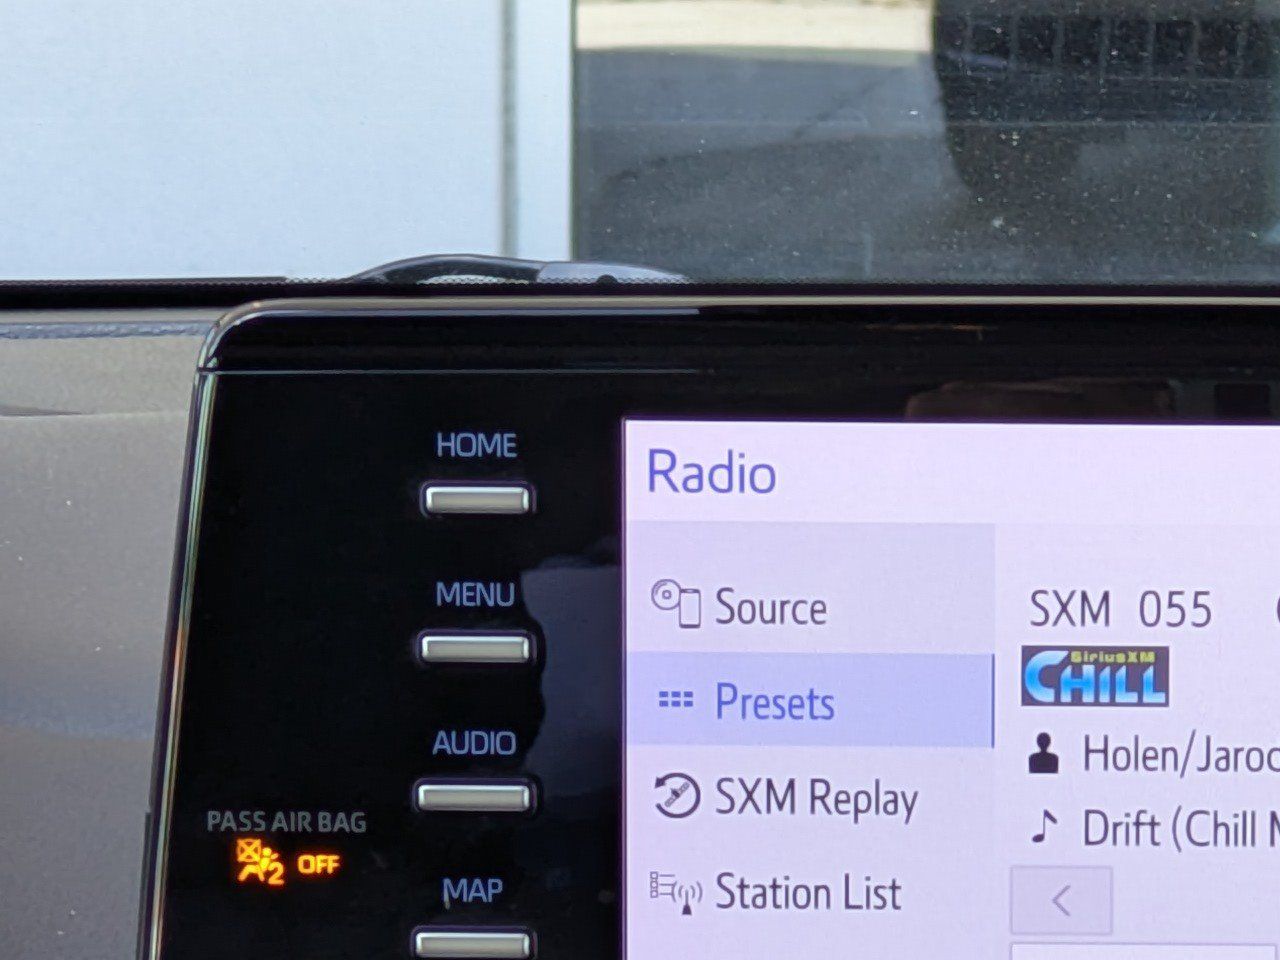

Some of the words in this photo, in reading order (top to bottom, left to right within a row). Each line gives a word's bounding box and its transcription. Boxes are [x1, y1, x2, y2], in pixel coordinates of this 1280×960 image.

[438, 432, 517, 458] HOME
[648, 448, 777, 494] Radio
[436, 581, 515, 607] MENU
[715, 586, 828, 626] Source
[1030, 589, 1111, 627] SXM
[1139, 590, 1212, 628] 055
[1025, 650, 1166, 703] CHILL
[716, 682, 835, 721] Presets
[432, 730, 517, 755] AUDIO
[716, 777, 796, 815] SXM
[810, 778, 919, 825] Replay
[207, 810, 266, 832] PASS
[271, 811, 312, 833] AIR
[317, 811, 367, 833] BAG
[1084, 809, 1161, 847] Drift
[1171, 805, 1256, 853] (Chill
[297, 854, 341, 874] OFF
[443, 878, 503, 903] MAP
[716, 871, 831, 910] Station
[844, 872, 902, 911] List
